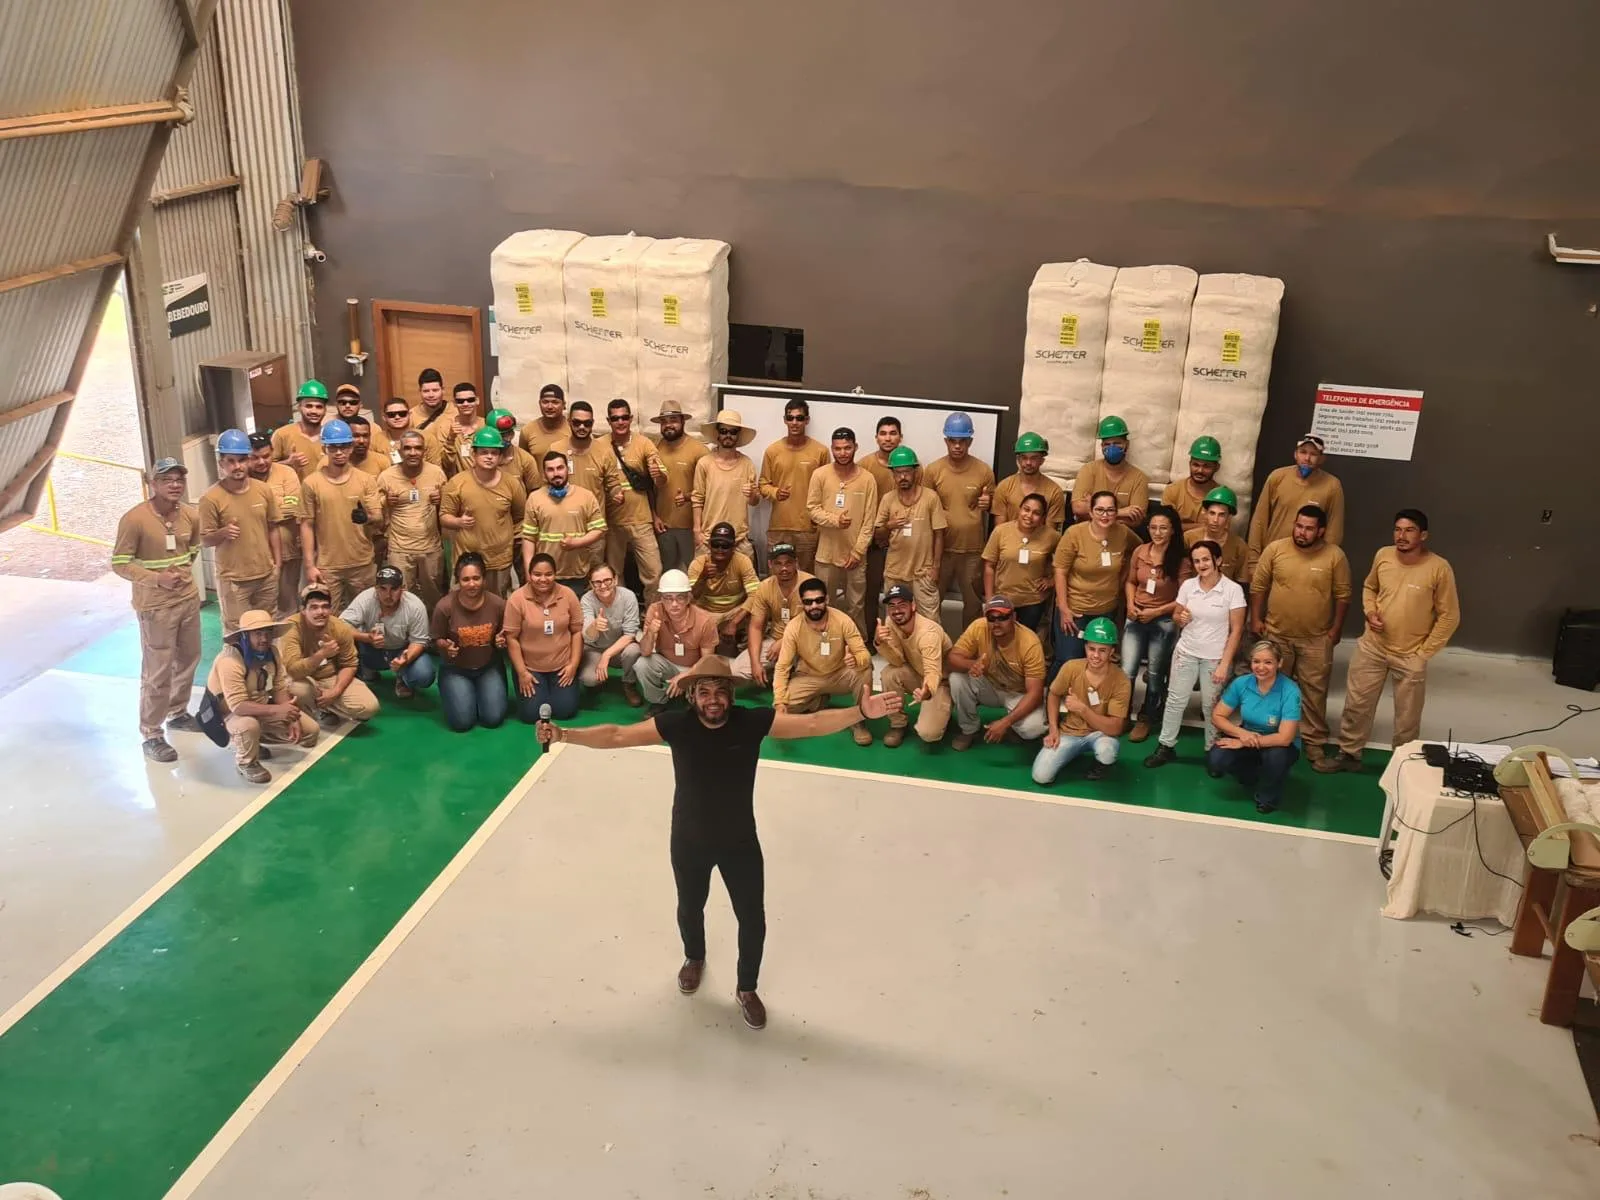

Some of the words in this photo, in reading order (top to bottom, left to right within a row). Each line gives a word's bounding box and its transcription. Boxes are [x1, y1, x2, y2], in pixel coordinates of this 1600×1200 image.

[167, 301, 209, 322] BEBEDOURO
[1322, 394, 1357, 403] TELEFONES
[1369, 398, 1409, 407] EMERGÊNCIA
